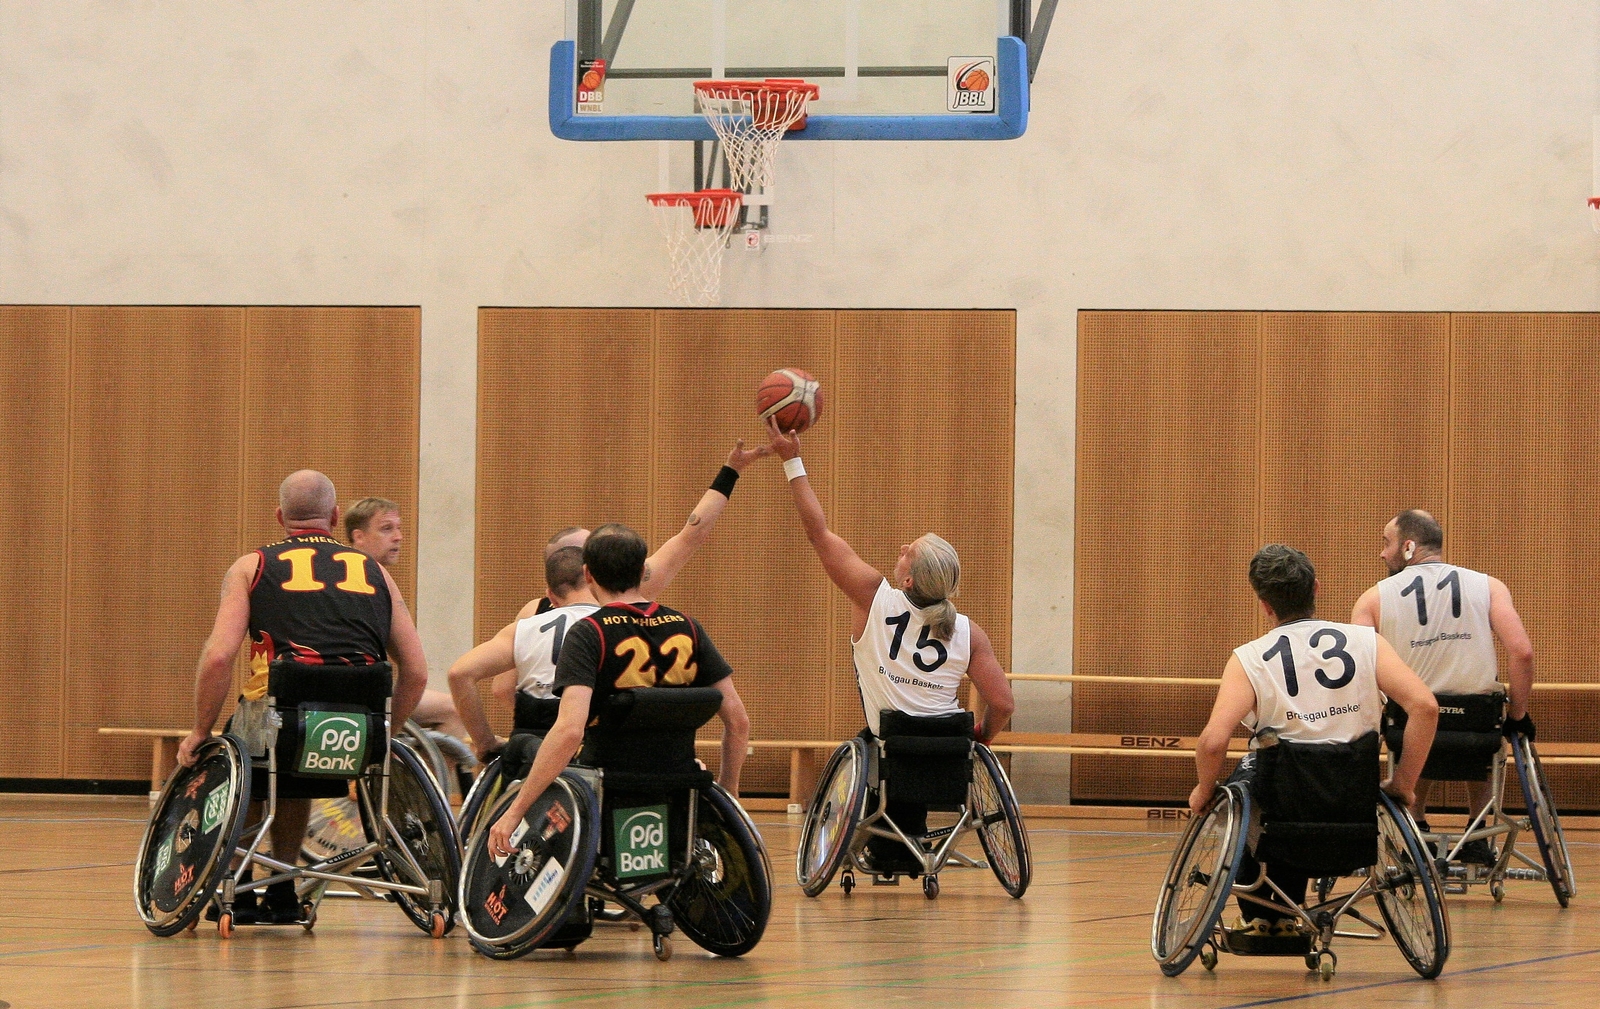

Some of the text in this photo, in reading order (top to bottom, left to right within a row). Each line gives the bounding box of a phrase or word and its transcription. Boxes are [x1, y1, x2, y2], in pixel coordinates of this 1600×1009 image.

[580, 91, 603, 101] DBB
[953, 91, 986, 109] JBBL
[278, 547, 377, 595] 11
[1400, 570, 1461, 626] 11
[603, 615, 628, 625] HOT
[885, 610, 948, 672] 15
[613, 633, 699, 688] 22
[1262, 628, 1356, 697] 13
[1329, 703, 1361, 717] Baske
[1438, 706, 1466, 715] EYRA
[321, 729, 360, 752] psd
[1120, 736, 1181, 748] BENZ
[305, 752, 357, 771] Bank
[1146, 809, 1192, 820] BEN
[630, 823, 664, 850] psd
[620, 849, 665, 873] Bank
